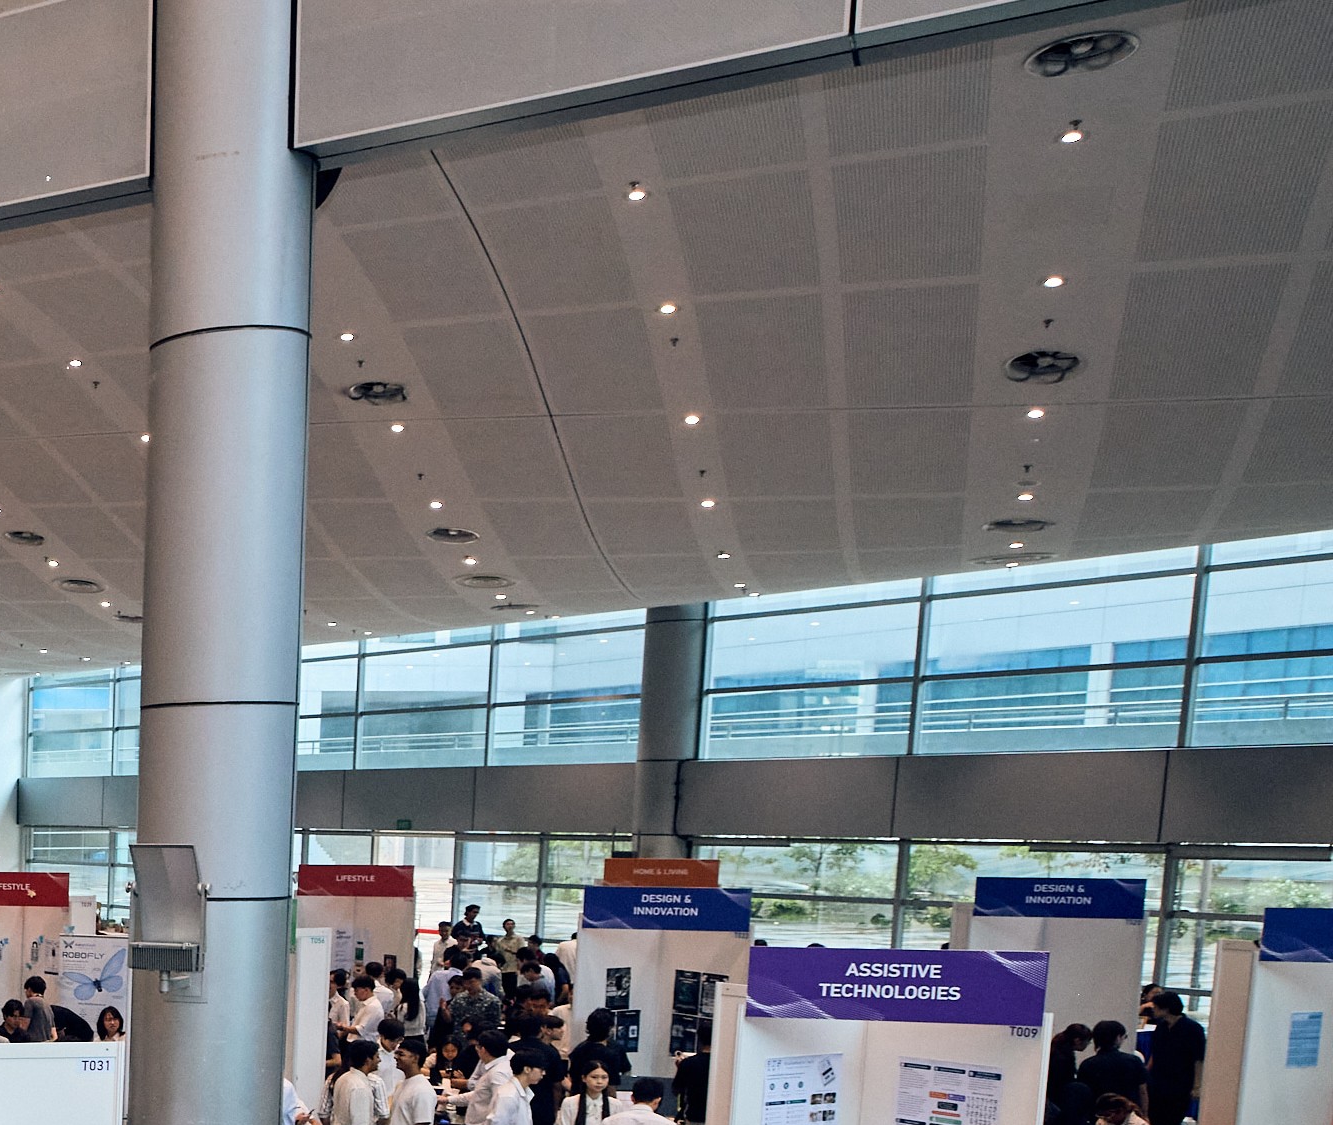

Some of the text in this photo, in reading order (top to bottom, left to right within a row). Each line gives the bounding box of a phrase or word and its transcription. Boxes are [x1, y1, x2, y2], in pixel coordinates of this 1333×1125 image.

[336, 874, 375, 882] LIFESTYLE
[1033, 884, 1085, 893] DESIGN &
[641, 894, 692, 903] DESIGN &
[1025, 896, 1093, 905] INNOVATION
[633, 906, 699, 916] INNOVATION
[62, 952, 105, 960] ROBOFLY
[845, 963, 942, 980] ASSISTIVE
[818, 982, 962, 1003] TECHNOLOGIES
[1010, 1026, 1038, 1038] T009
[81, 1060, 111, 1071] T031
